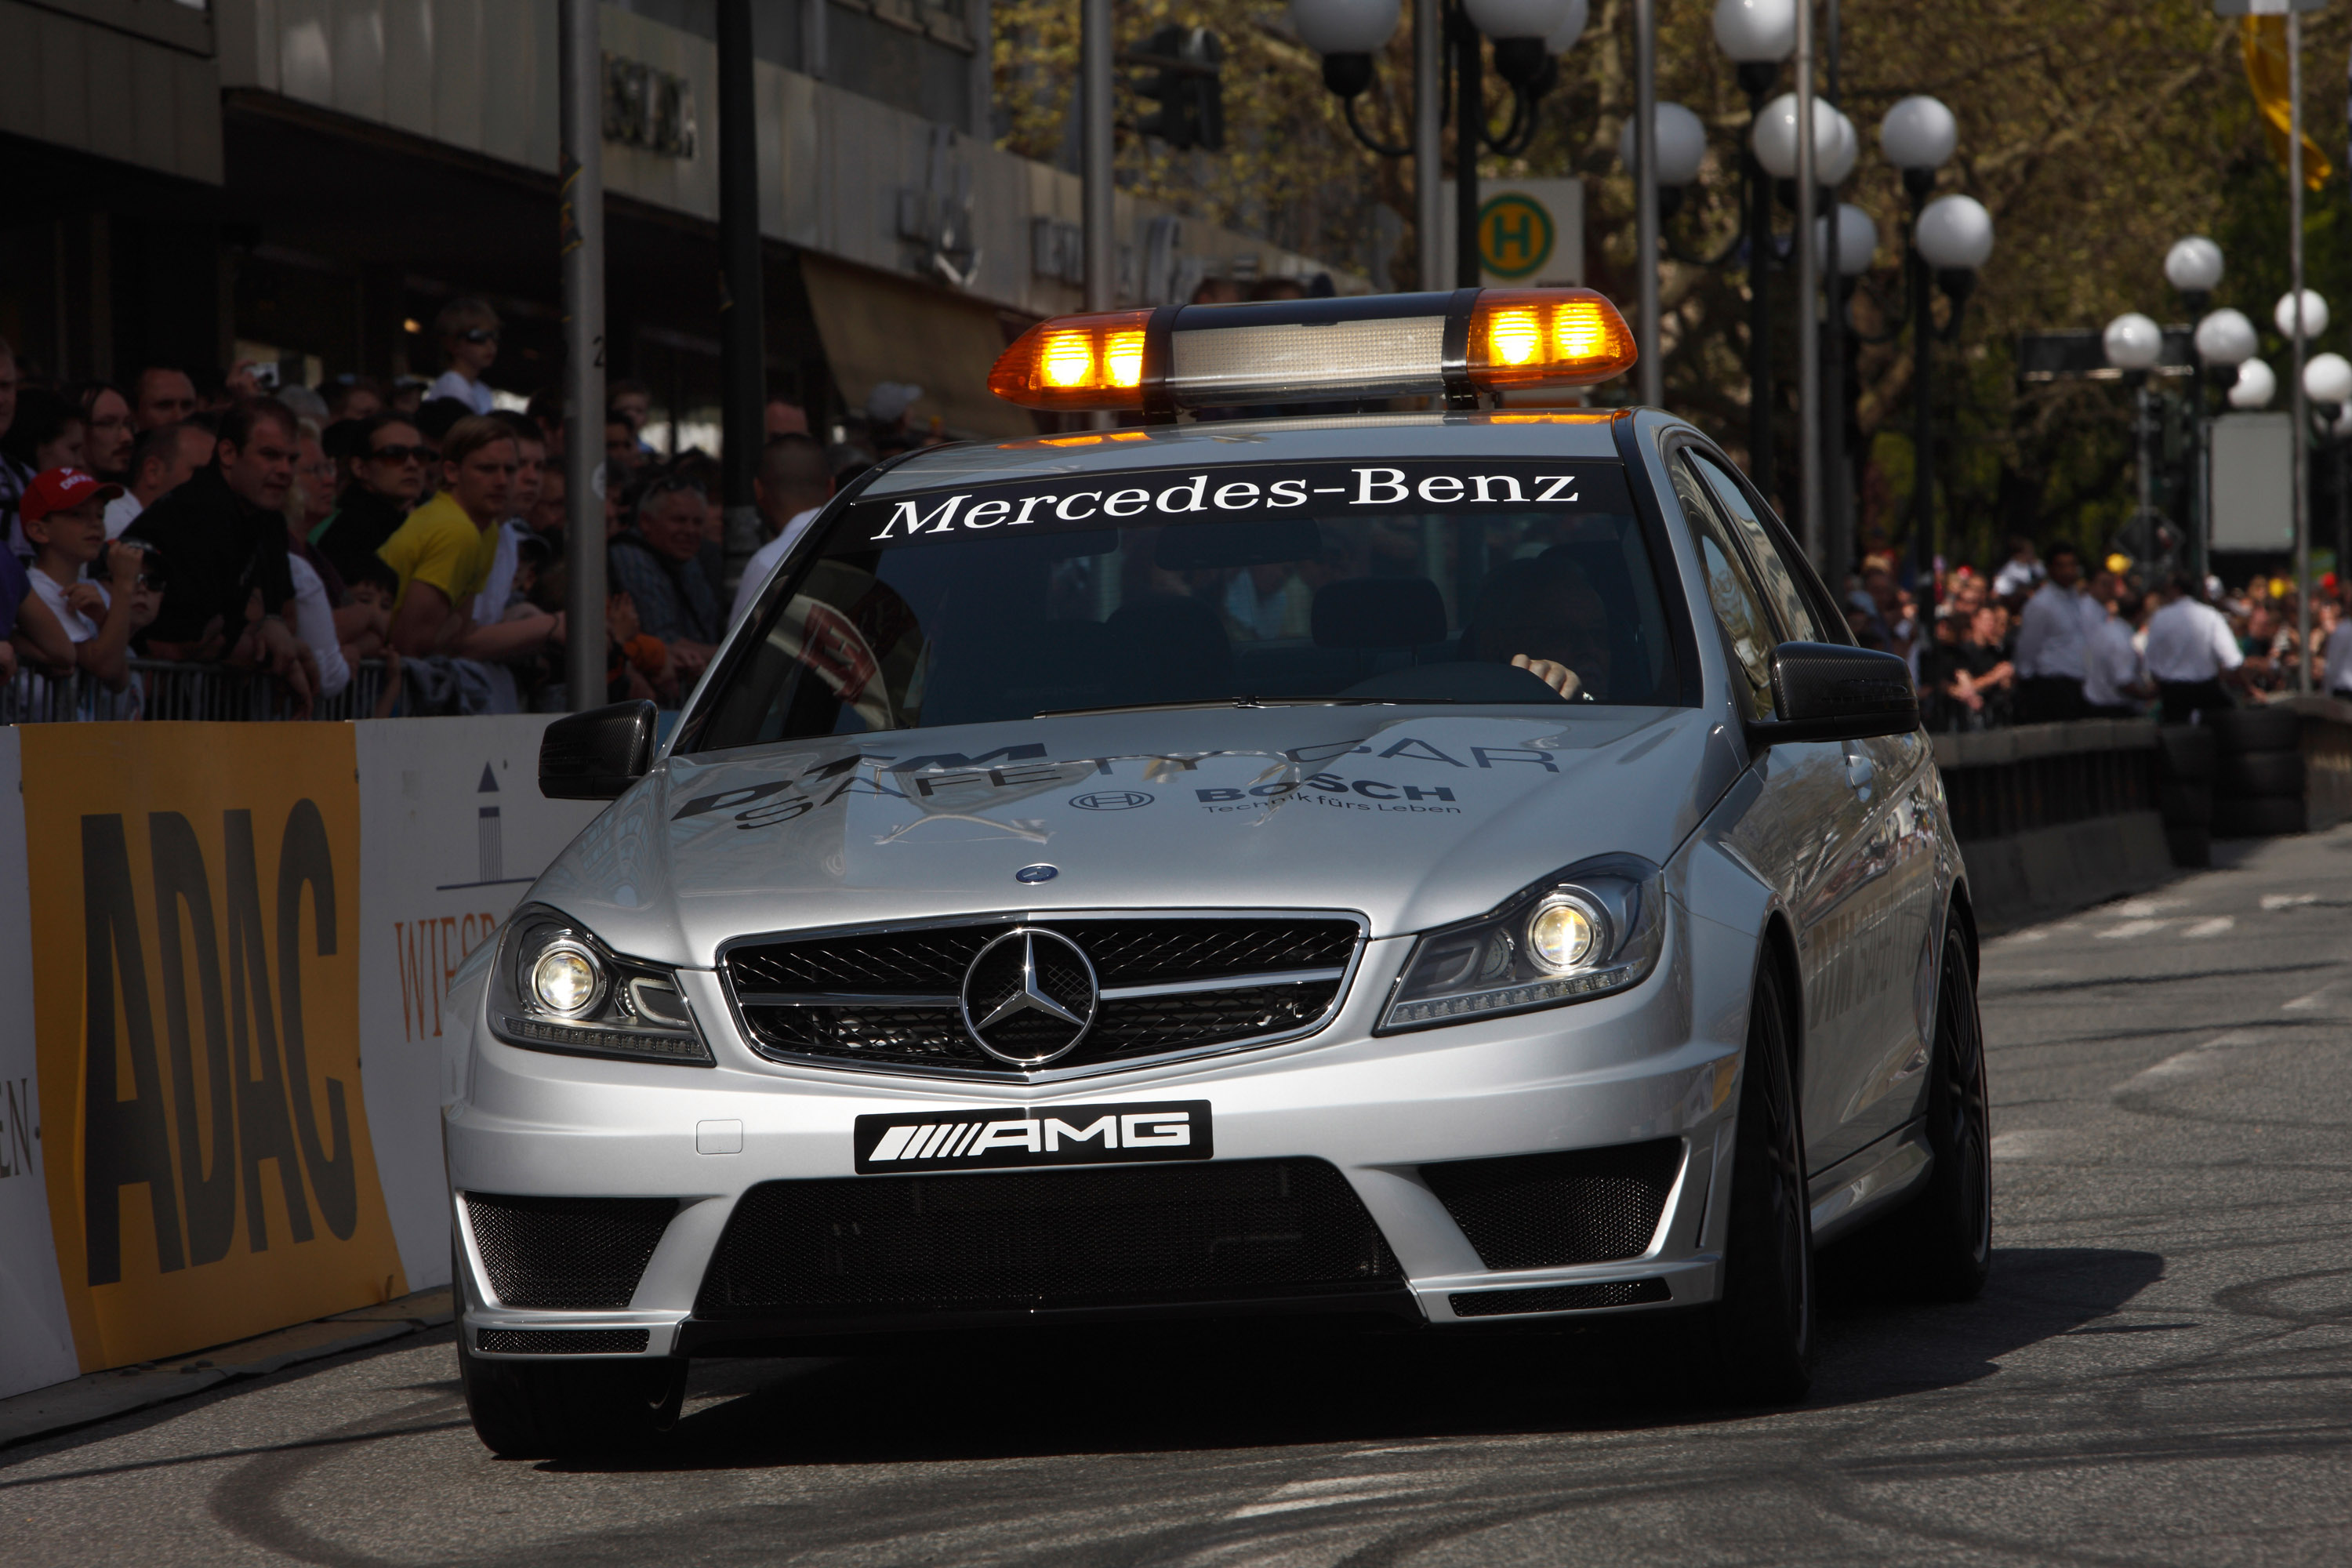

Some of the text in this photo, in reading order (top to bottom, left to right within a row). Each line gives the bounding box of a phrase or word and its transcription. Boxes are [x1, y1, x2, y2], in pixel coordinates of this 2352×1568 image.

[1494, 216, 1530, 260] H
[869, 468, 1579, 540] Mercedes-Benz
[1284, 737, 1560, 774] CAR
[670, 742, 1047, 821] DTM
[1195, 772, 1456, 803] BOSCH
[1202, 792, 1461, 814] Technik fürs Leben
[81, 798, 357, 1287] ADAC
